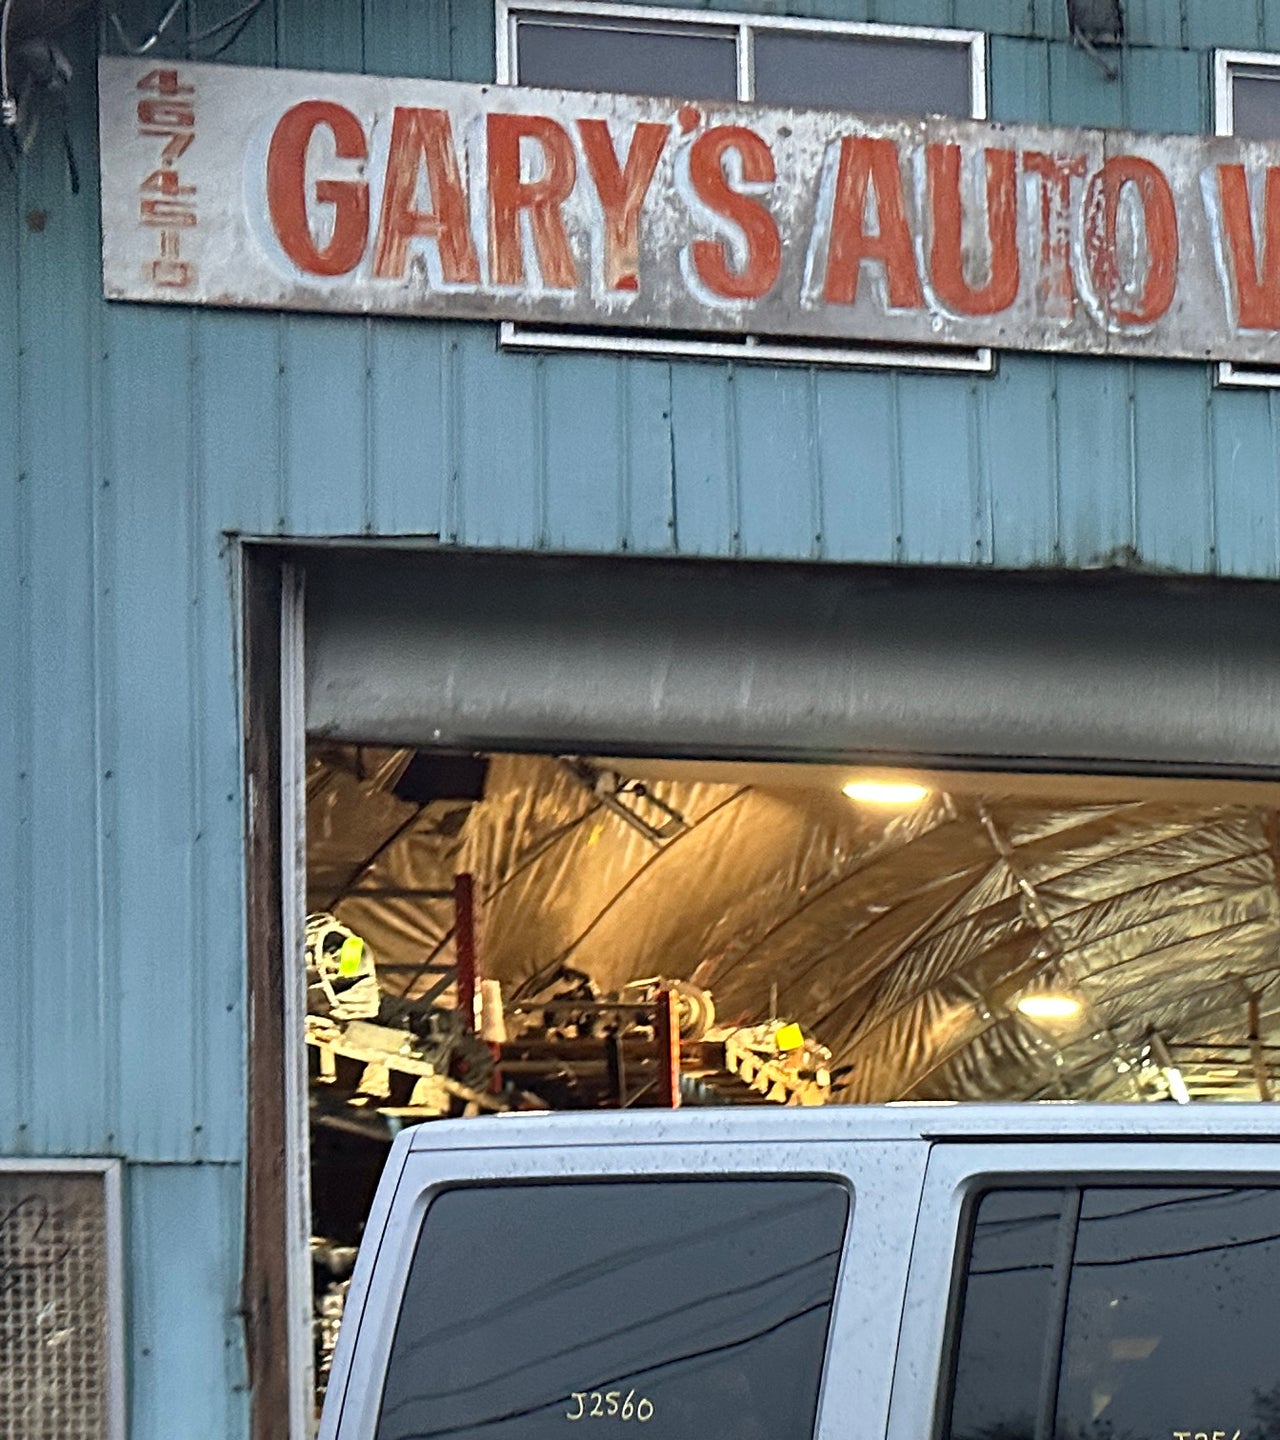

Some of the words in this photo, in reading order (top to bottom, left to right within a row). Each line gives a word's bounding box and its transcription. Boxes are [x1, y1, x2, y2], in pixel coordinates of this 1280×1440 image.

[266, 98, 781, 300] GARY'S
[823, 137, 1178, 325] AUTO
[566, 1388, 654, 1421] J2560
